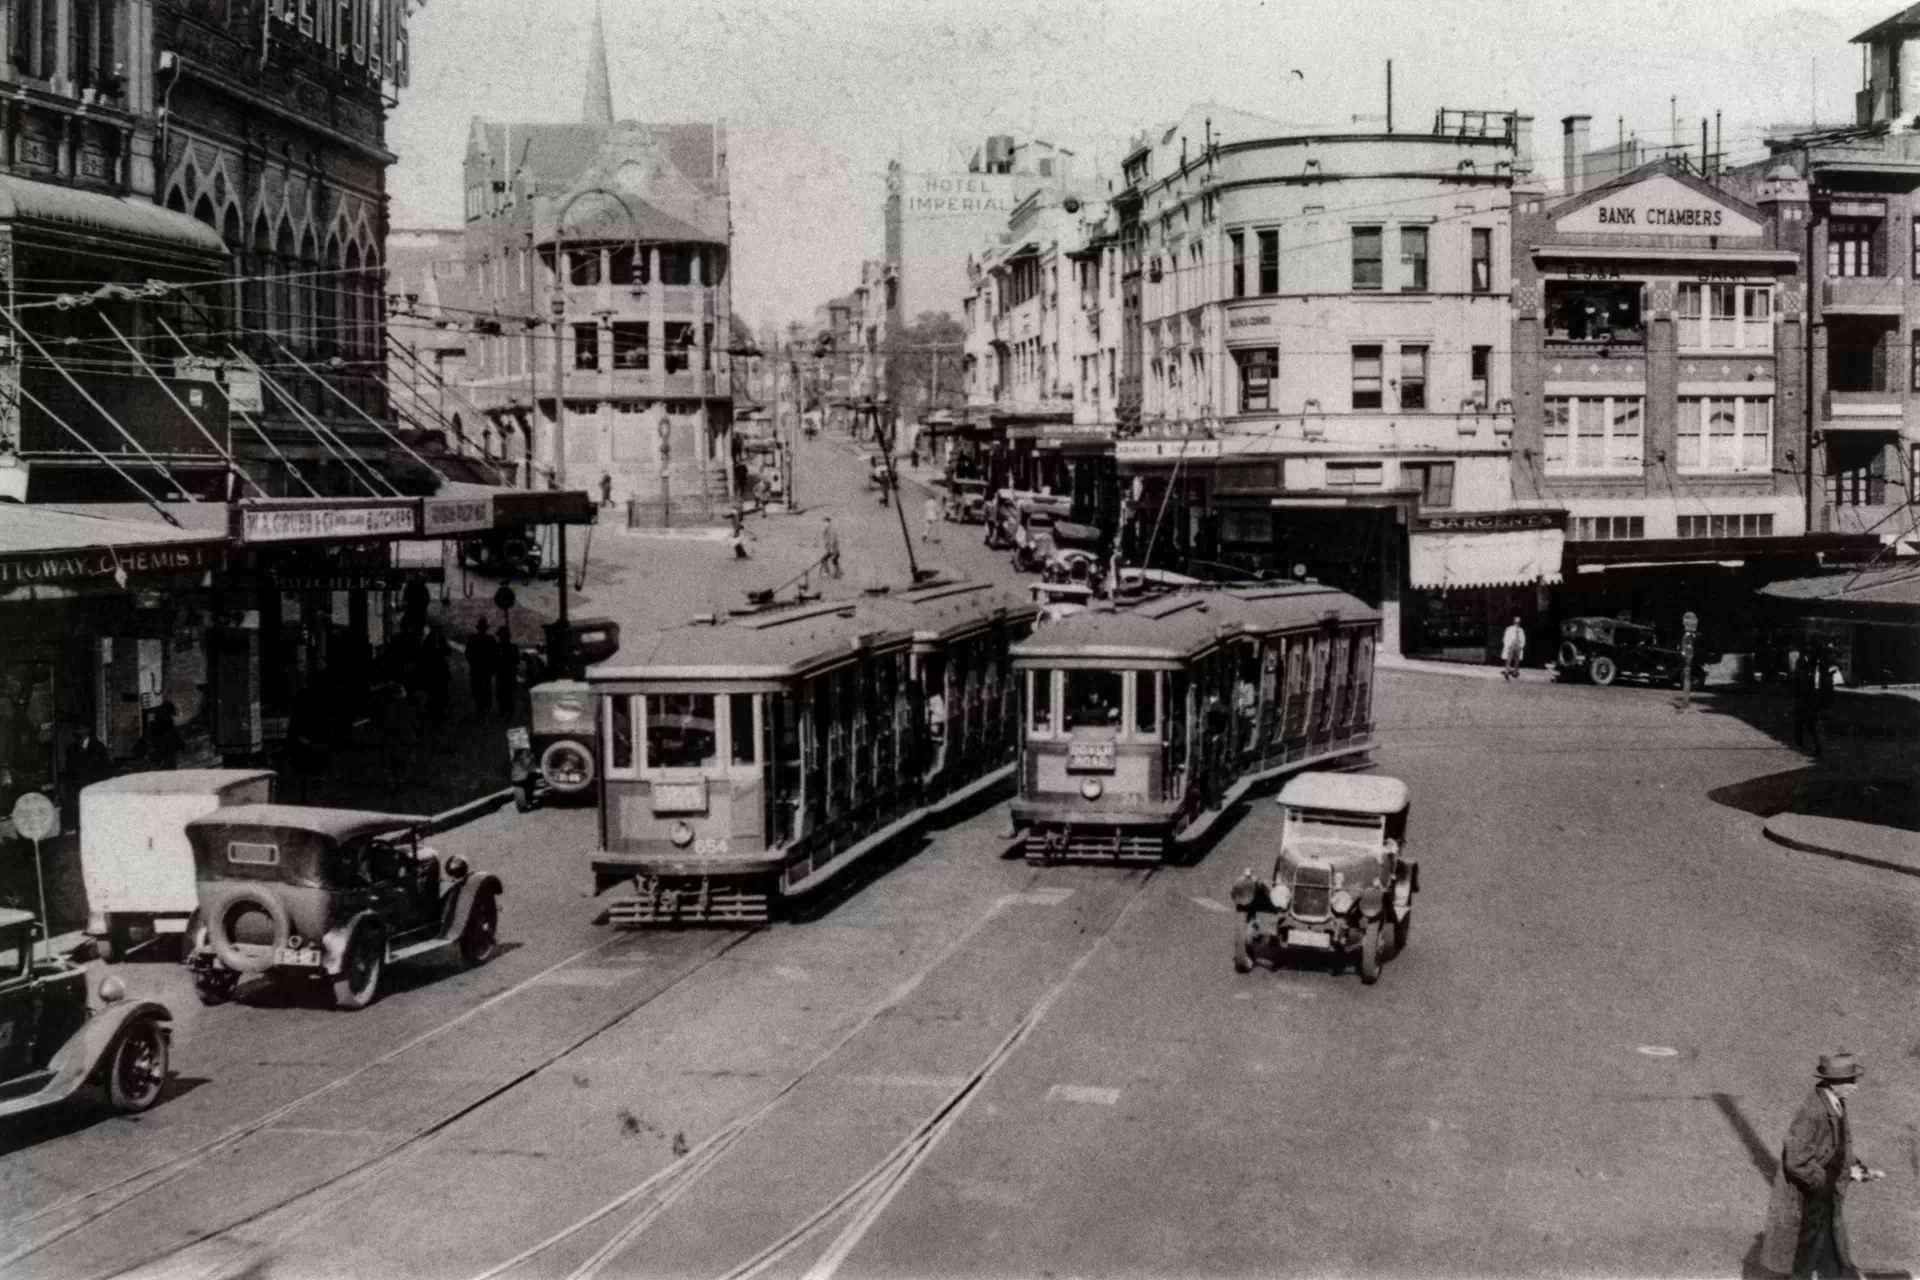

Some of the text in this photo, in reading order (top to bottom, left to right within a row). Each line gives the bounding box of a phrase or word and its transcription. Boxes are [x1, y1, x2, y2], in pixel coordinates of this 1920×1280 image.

[926, 179, 991, 193] HOTEL
[909, 197, 1007, 212] IMPERIAL
[1598, 206, 1722, 226] BANK CHAMBERS
[693, 837, 729, 855] 654
